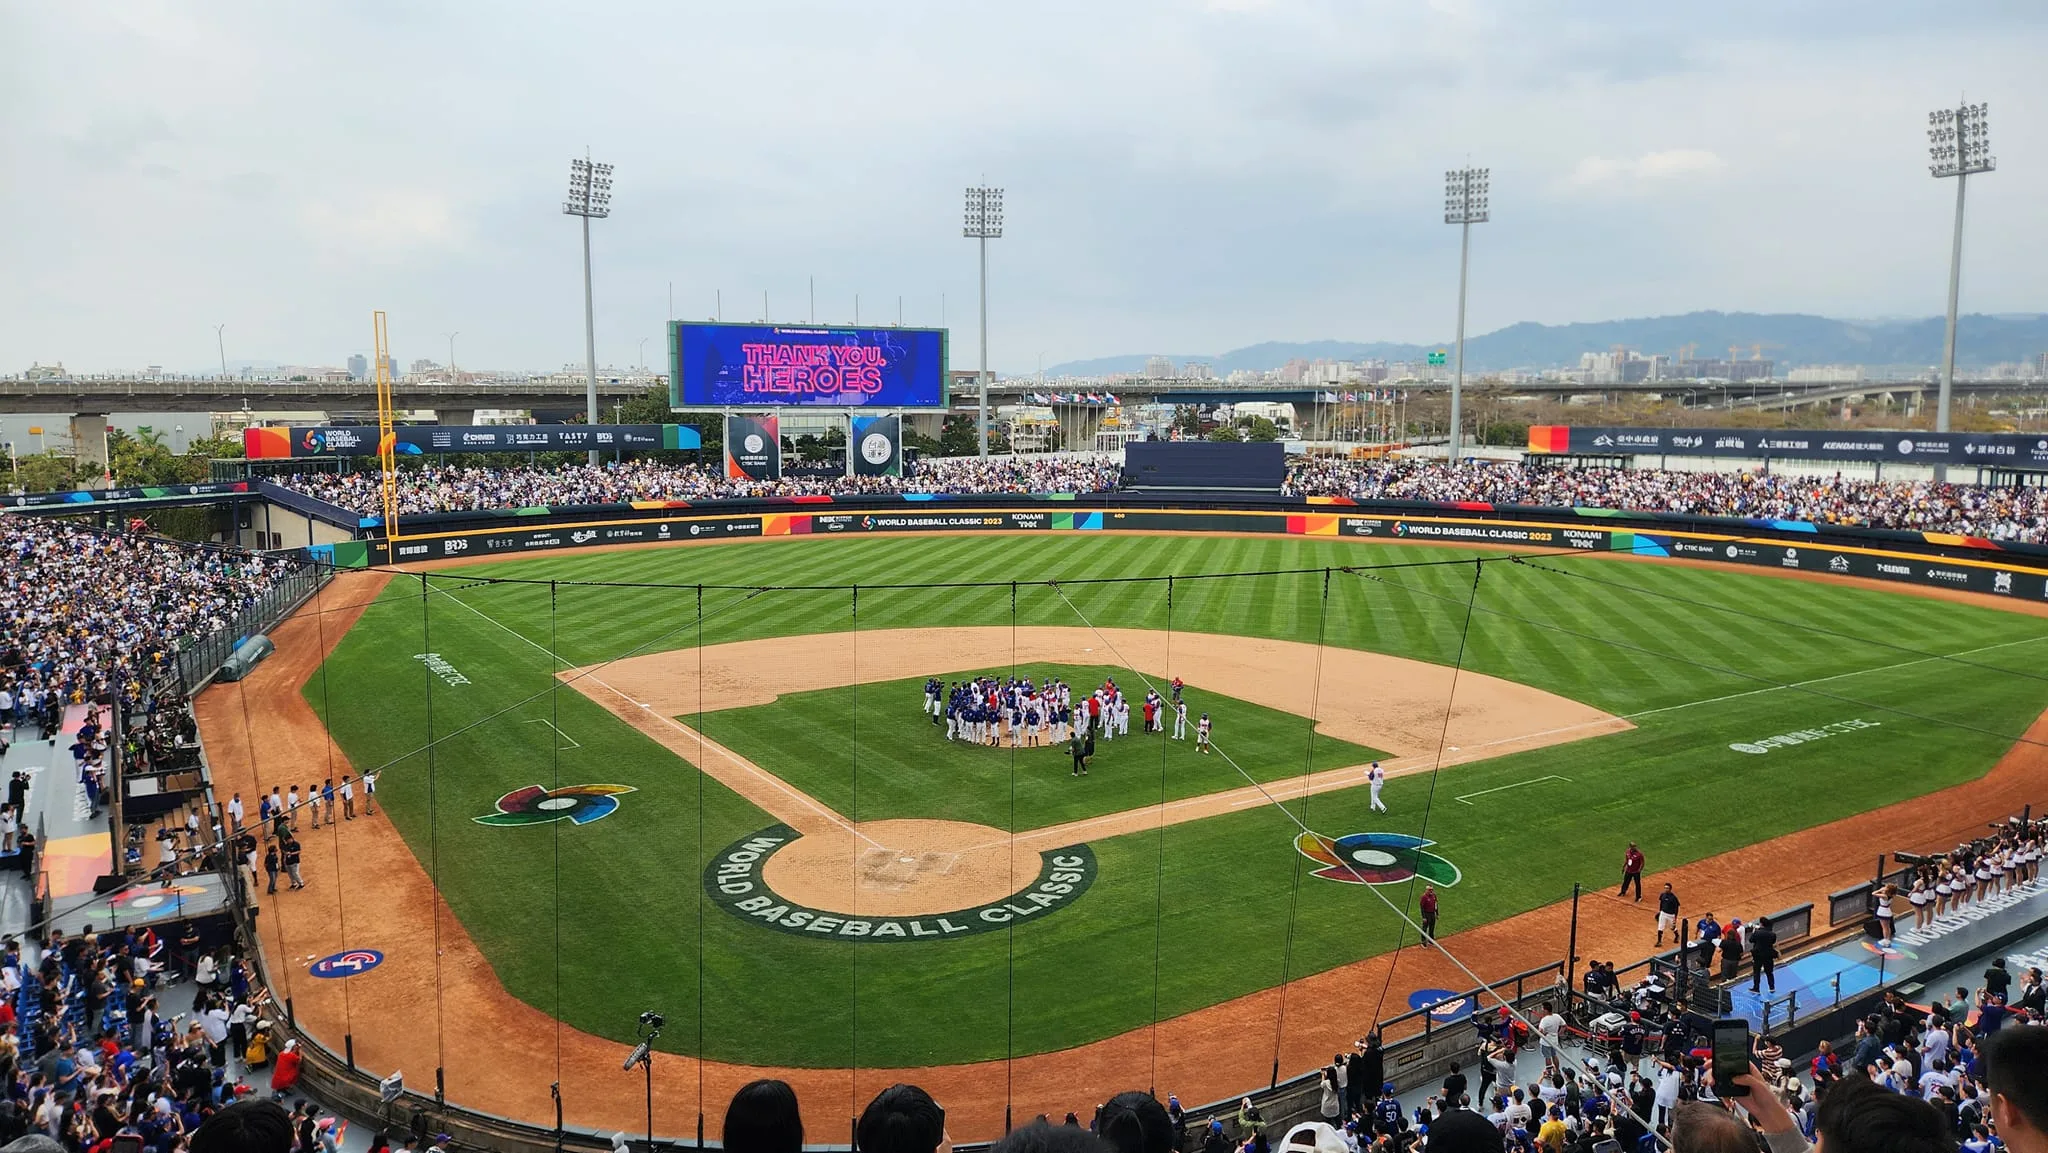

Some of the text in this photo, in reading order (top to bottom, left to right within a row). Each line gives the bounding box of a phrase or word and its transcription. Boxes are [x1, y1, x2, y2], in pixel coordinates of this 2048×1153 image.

[742, 343, 887, 367] THANK YOU.
[743, 365, 882, 394] HEROES
[558, 432, 588, 440] TASTY
[1822, 441, 1856, 450] KENDA
[907, 518, 948, 526] BASEBALL
[949, 517, 982, 525] CLASSIC
[983, 517, 1003, 525] 2023
[1409, 525, 1552, 541] WORLD BASEBALL CLASSIC 2023
[1563, 530, 1602, 540] KONAMI
[1684, 544, 1714, 553] CTBC BANK
[717, 837, 1084, 937] WORLD BASEBALL CLASSIC
[1385, 1110, 1397, 1123] 50
